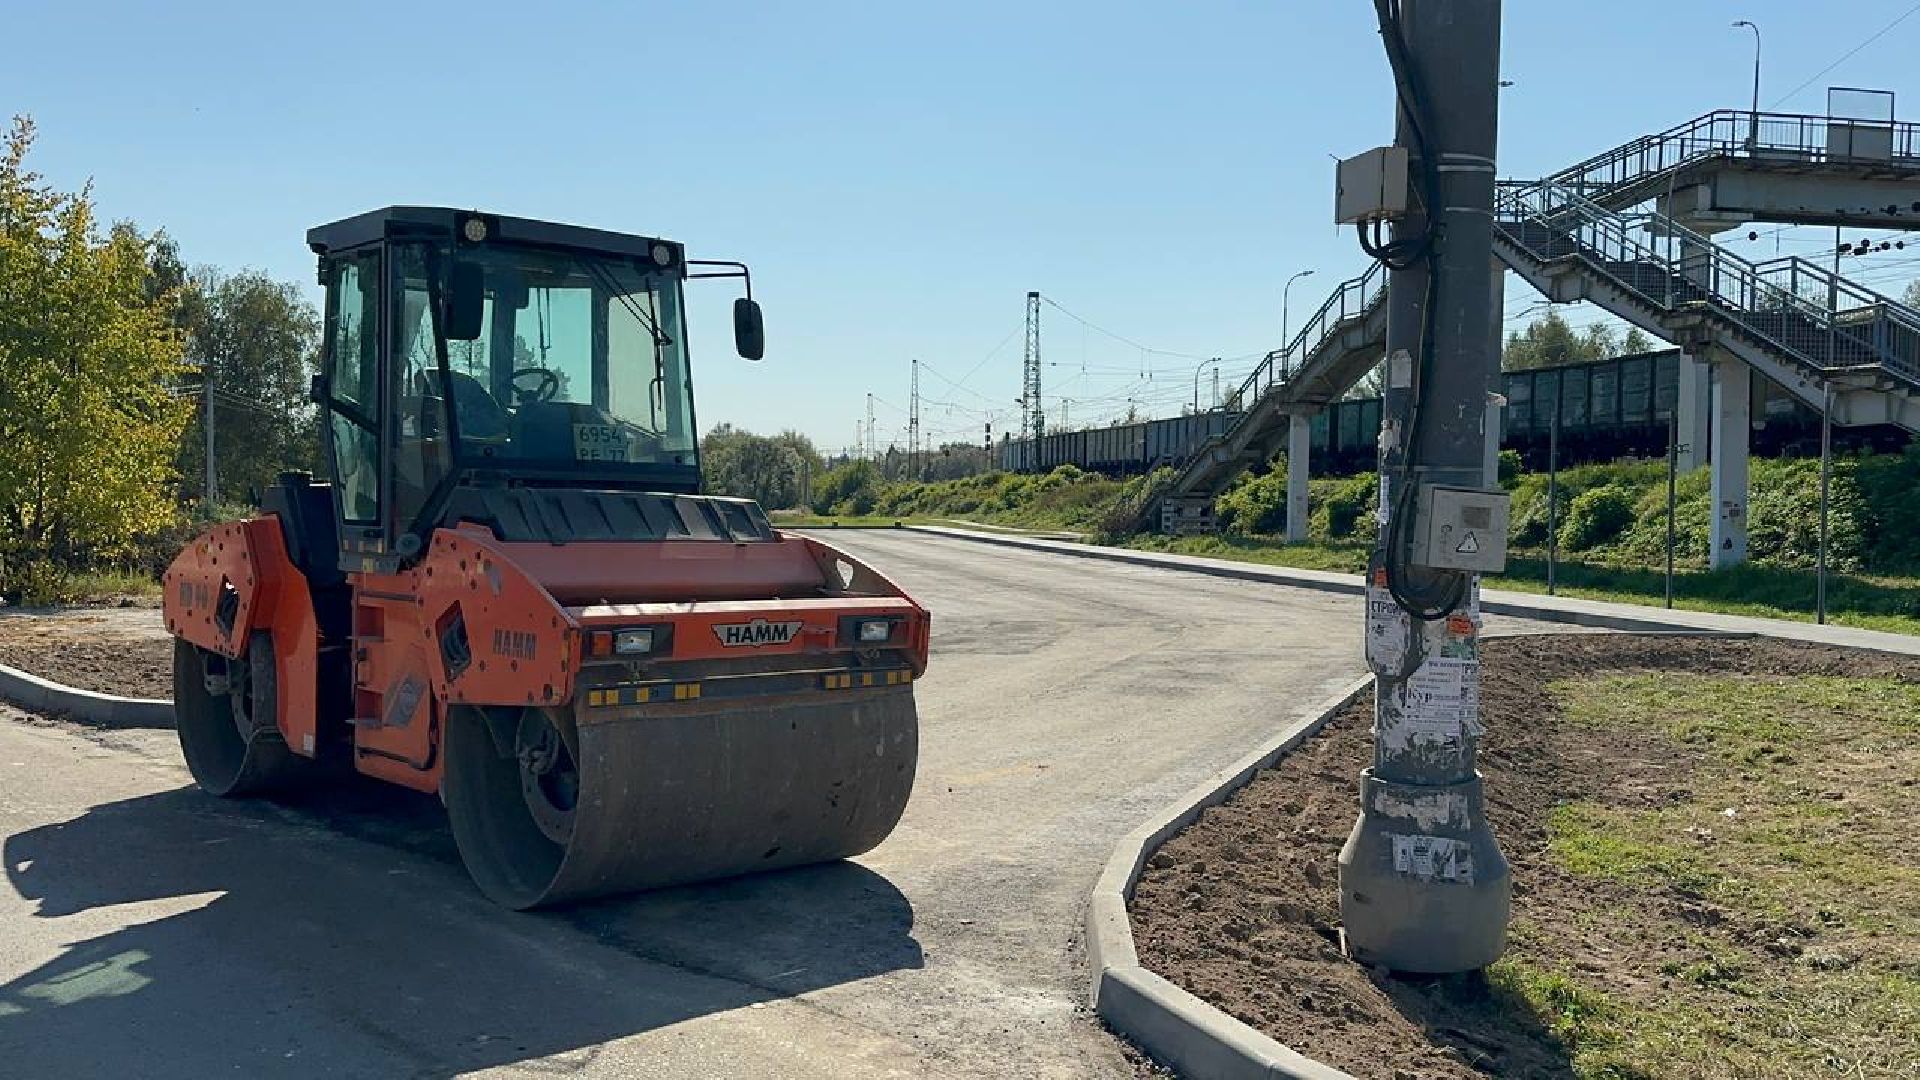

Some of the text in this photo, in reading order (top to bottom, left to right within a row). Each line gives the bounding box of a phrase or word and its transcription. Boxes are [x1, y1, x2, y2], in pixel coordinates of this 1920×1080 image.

[580, 426, 622, 444] 6954
[726, 624, 788, 643] HAMM
[493, 629, 536, 661] HAMM
